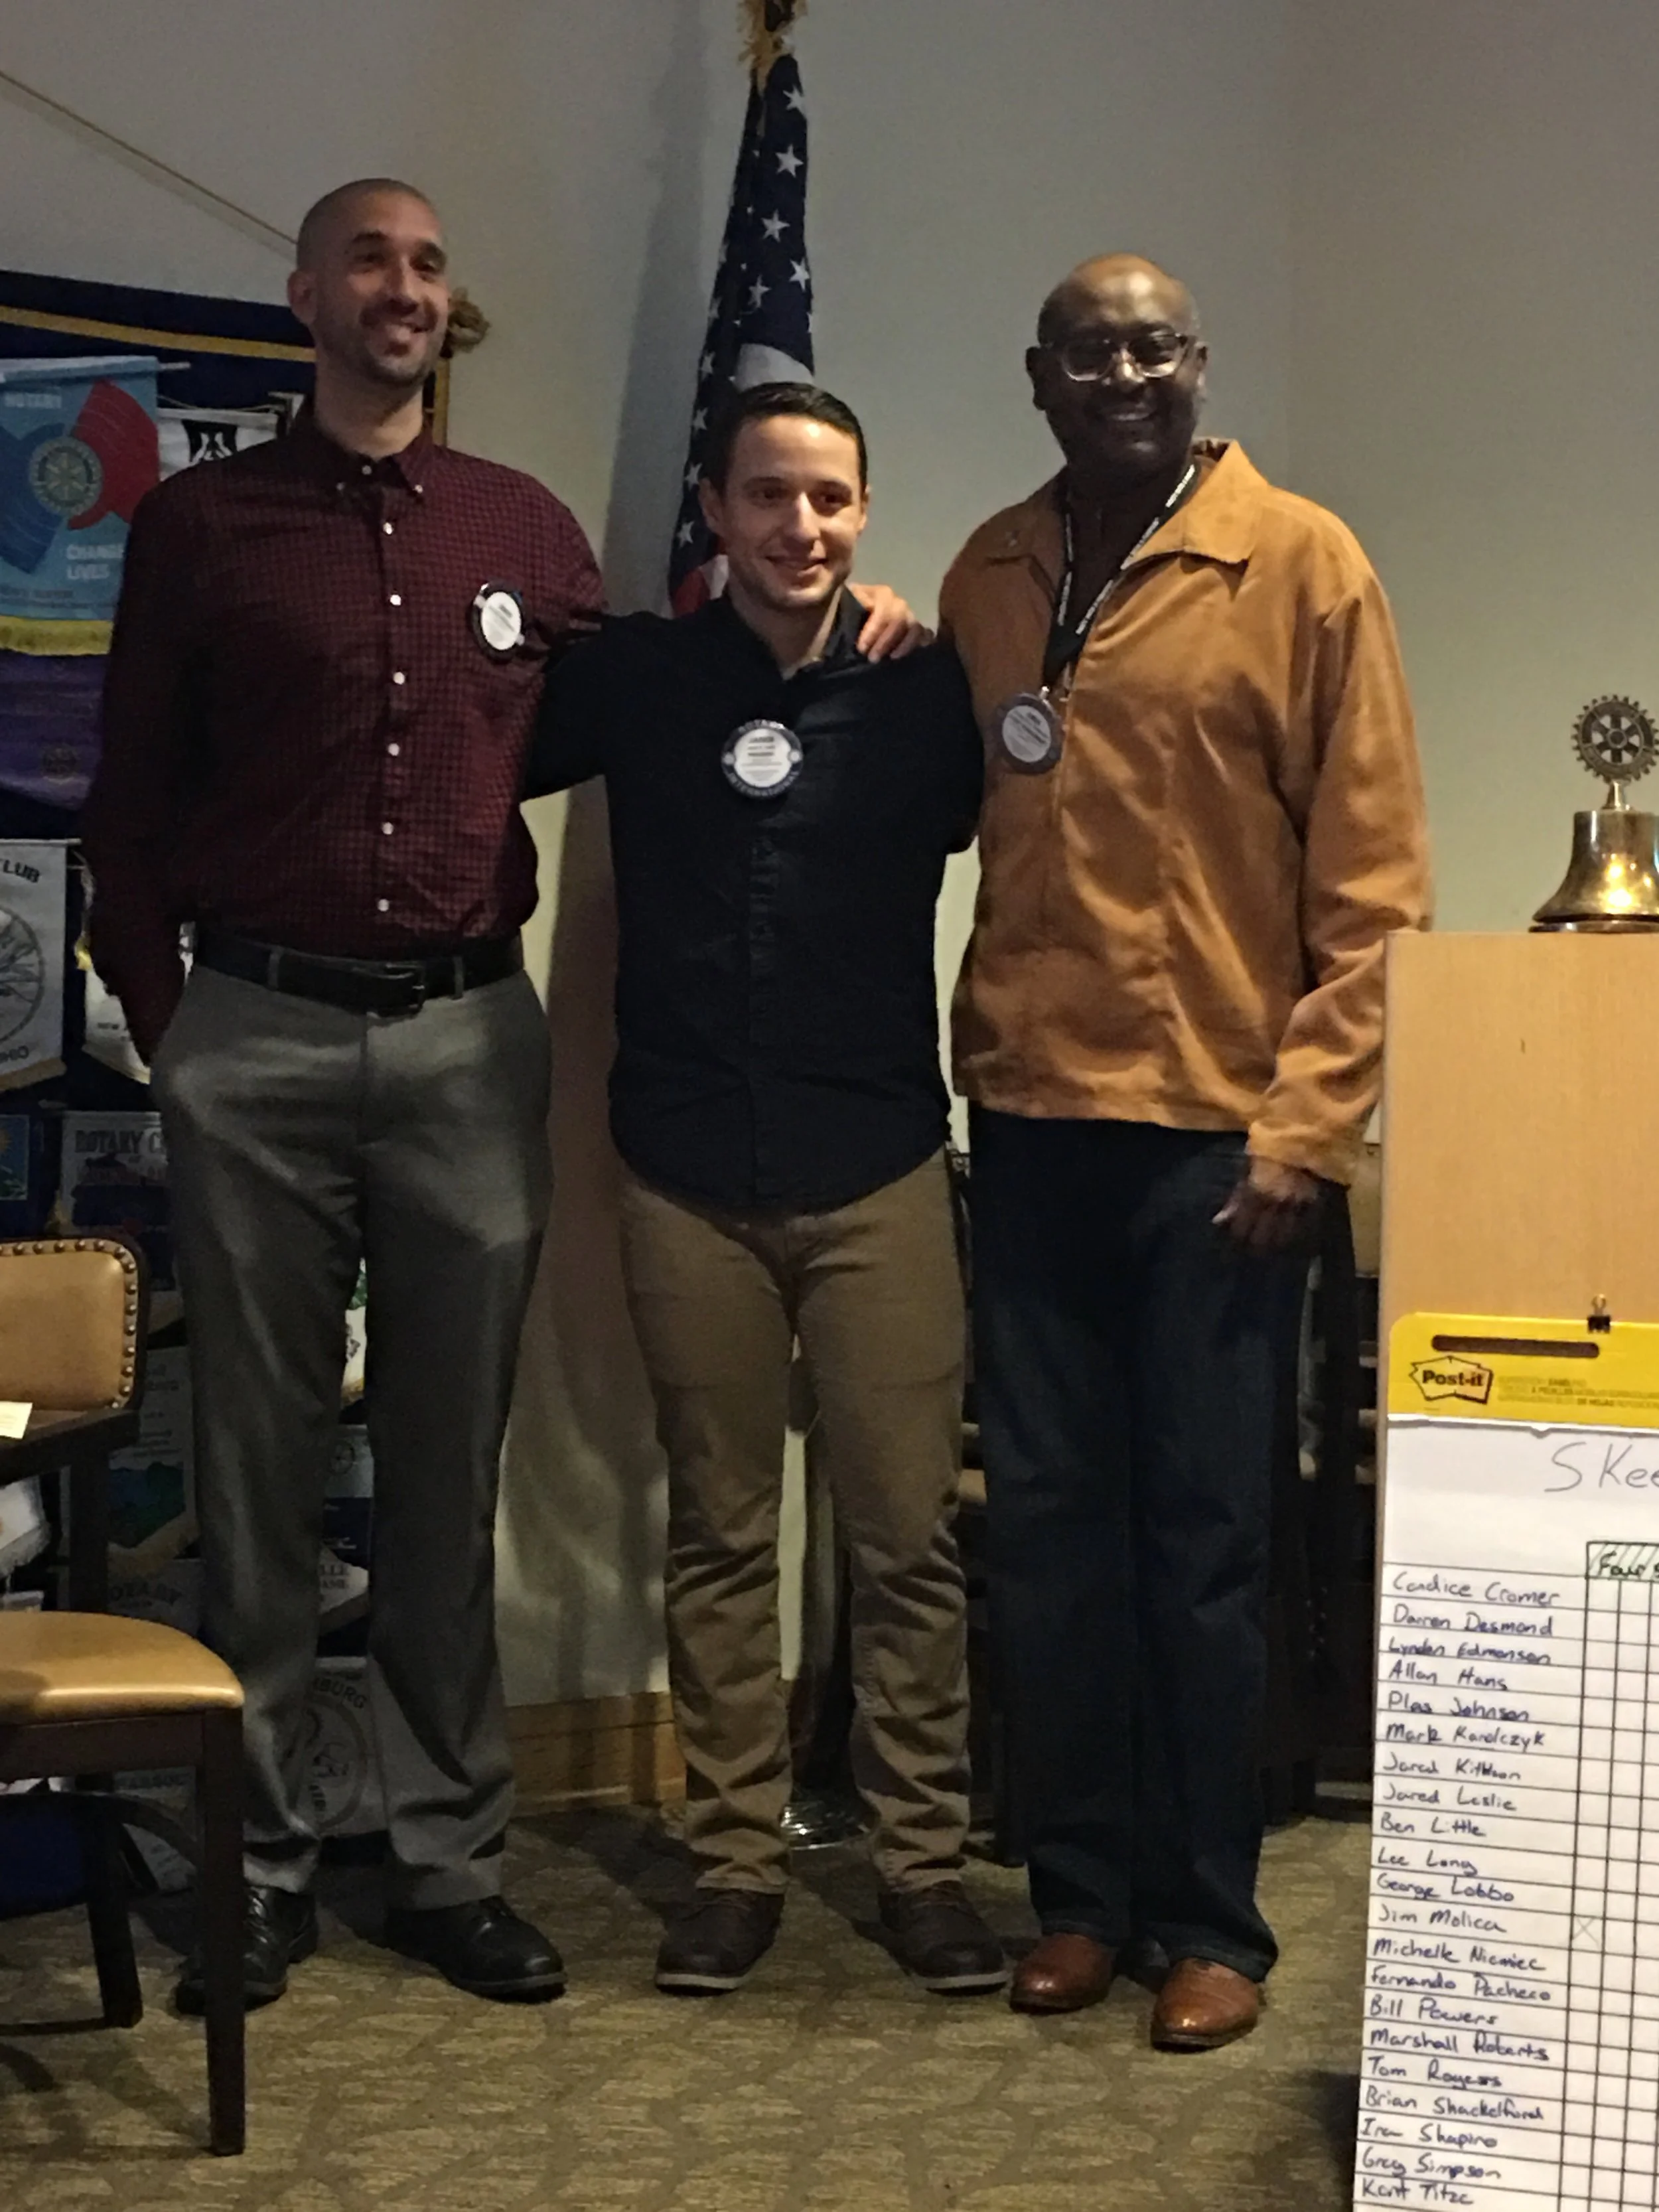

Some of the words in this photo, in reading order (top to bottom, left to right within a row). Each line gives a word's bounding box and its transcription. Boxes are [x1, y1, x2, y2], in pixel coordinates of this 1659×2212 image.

[0, 858, 40, 883] LUB
[1422, 1369, 1484, 1387] Post-it
[1393, 1571, 1474, 1597] Candice
[1484, 1582, 1560, 1607] Cromer
[1464, 1611, 1553, 1636] Desmond
[1451, 1696, 1530, 1722] Johnson
[1386, 1722, 1442, 1744] Mark
[1383, 1751, 1439, 1774] Jared
[1383, 1783, 1440, 1804] Jared
[1457, 1786, 1517, 1811] Leslie
[1381, 1812, 1415, 1834] Ben
[1378, 1847, 1410, 1866] Lee
[1426, 1850, 1479, 1877] Long
[1377, 1873, 1441, 1899] George
[1378, 1903, 1417, 1923] Jim
[1429, 1909, 1508, 1933] Molica
[1374, 1938, 1462, 1963] Michelle
[1371, 1964, 1457, 1989] Fernando
[1473, 1971, 1551, 2001] Pacheco
[1370, 1994, 1404, 2017] Bill
[1419, 1997, 1498, 2025] Powers
[1371, 2028, 1459, 2053] Marshall
[1474, 2029, 1550, 2061] Roberts
[1368, 2055, 1407, 2077] Tom
[1366, 2085, 1417, 2108] Brian
[1419, 2124, 1498, 2149] Shapiro
[1414, 2152, 1502, 2180] Simpson
